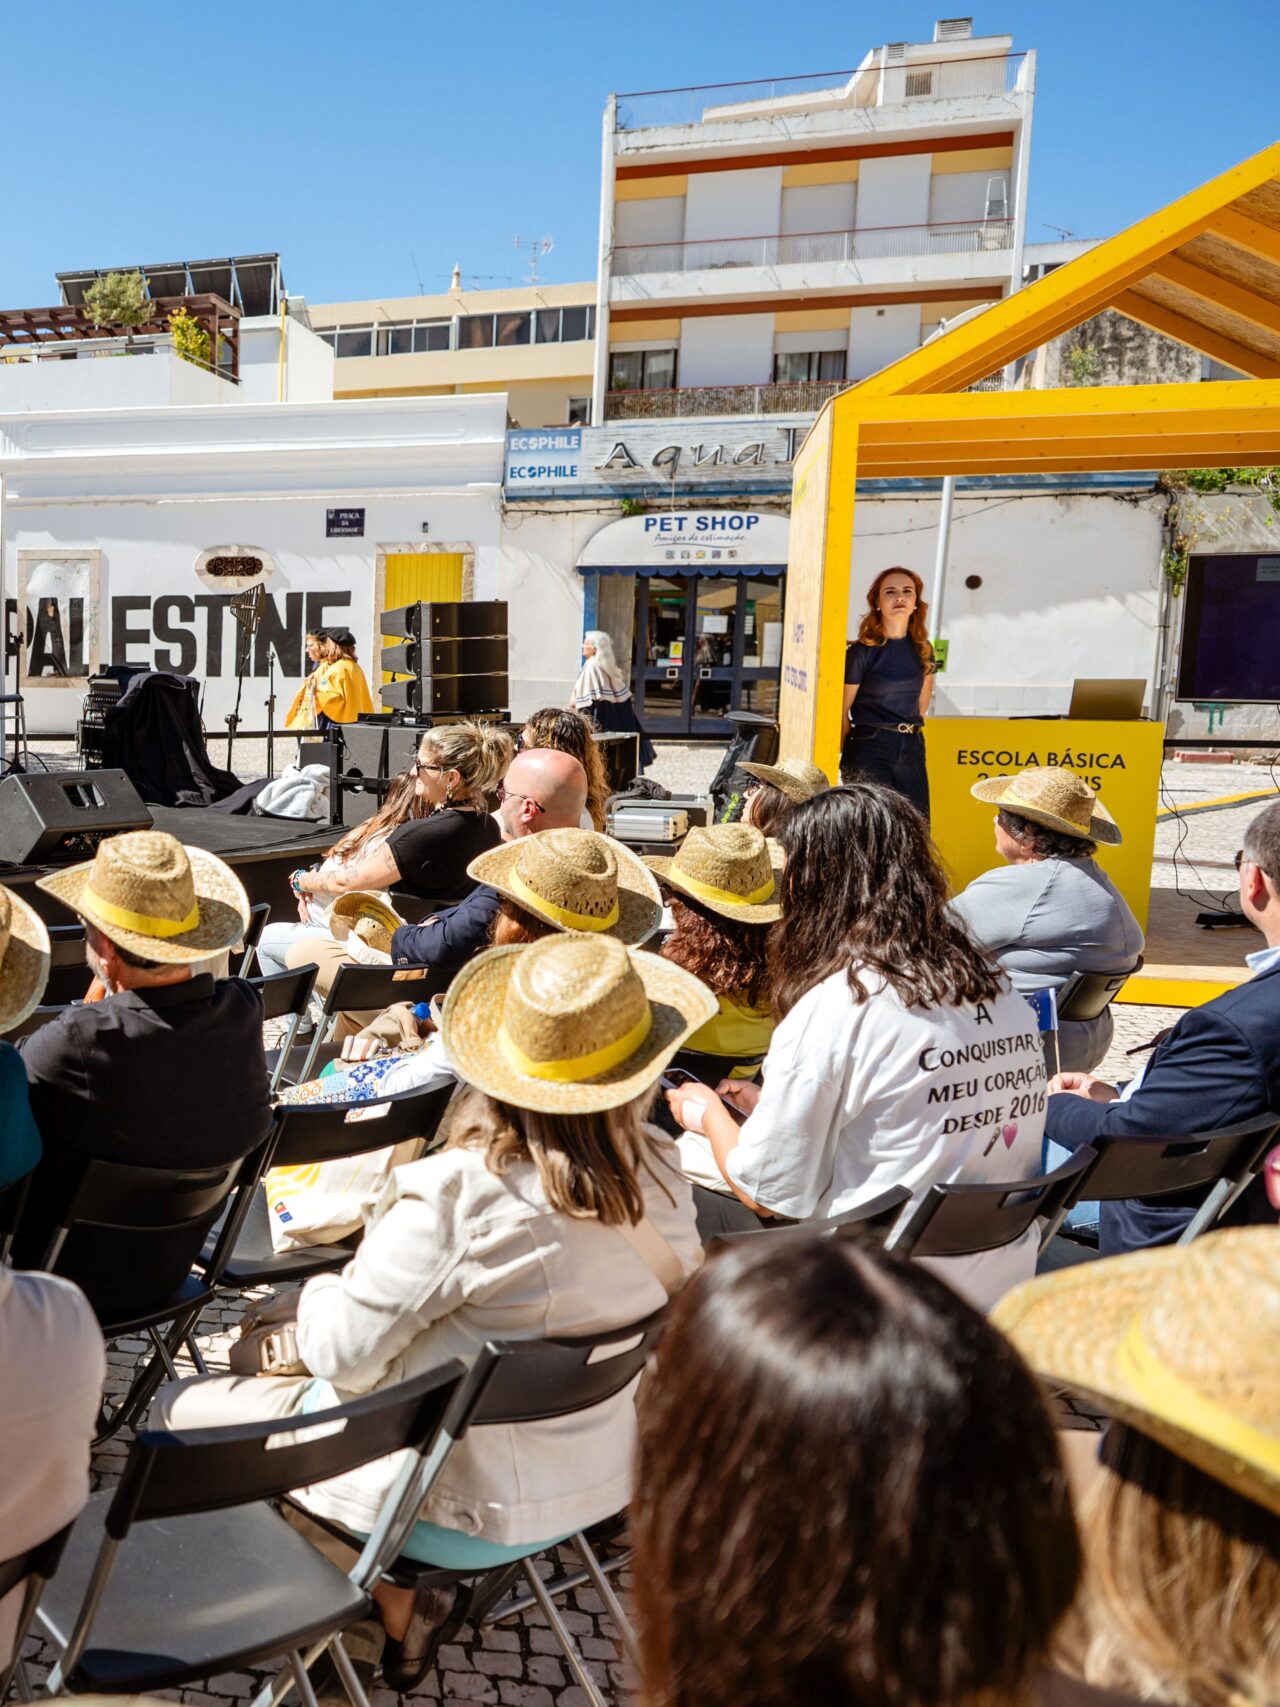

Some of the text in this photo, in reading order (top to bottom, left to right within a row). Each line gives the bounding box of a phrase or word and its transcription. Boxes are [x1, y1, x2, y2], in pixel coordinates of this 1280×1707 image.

[509, 435, 580, 451] ECOPHILE
[509, 464, 578, 479] ECOPHILE
[644, 515, 760, 532] PET SHOP
[654, 533, 686, 544] Amigos
[688, 533, 699, 541] de
[957, 747, 1126, 769] ESCOLA BÁSICA
[973, 1002, 993, 1025] A
[918, 1033, 1037, 1072] CONQUISTAR
[927, 1079, 978, 1104] MEU
[941, 1090, 1046, 1135] DESDE 2016
